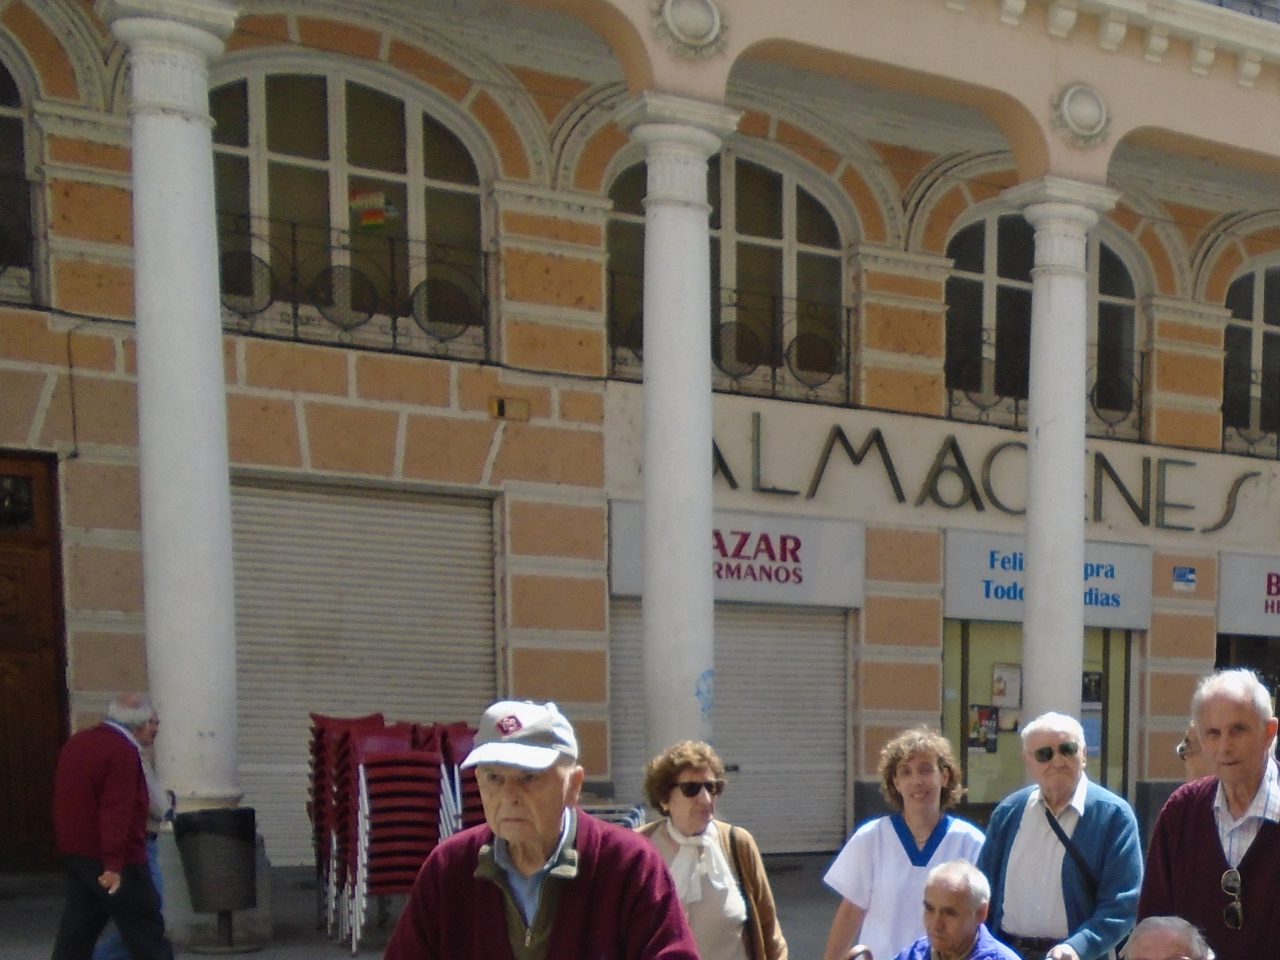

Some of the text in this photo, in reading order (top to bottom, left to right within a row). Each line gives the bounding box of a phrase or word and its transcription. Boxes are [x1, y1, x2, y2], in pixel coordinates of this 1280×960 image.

[712, 529, 802, 563] AZAR
[712, 561, 803, 585] RMANOS
[989, 550, 1024, 572] Feli
